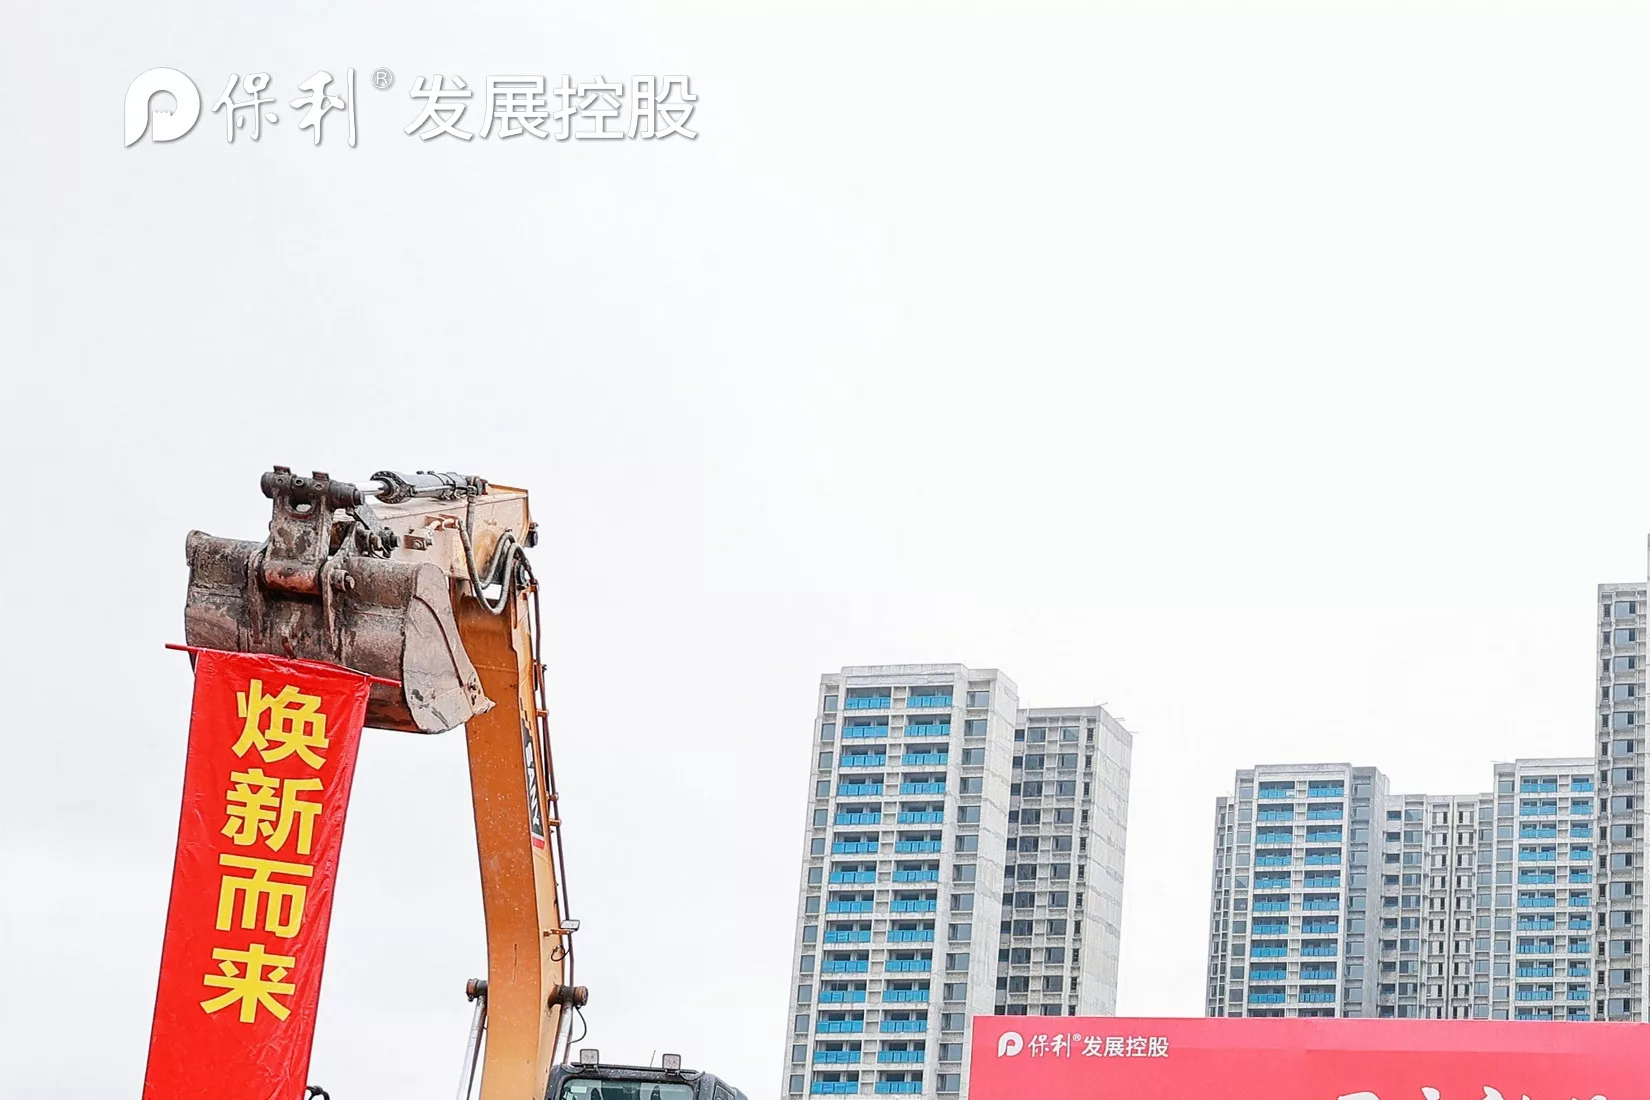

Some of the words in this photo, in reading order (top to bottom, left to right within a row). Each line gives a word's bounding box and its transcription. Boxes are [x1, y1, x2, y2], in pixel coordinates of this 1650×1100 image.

[199, 678, 331, 1024] 焕新而来
[524, 741, 541, 826] SANY
